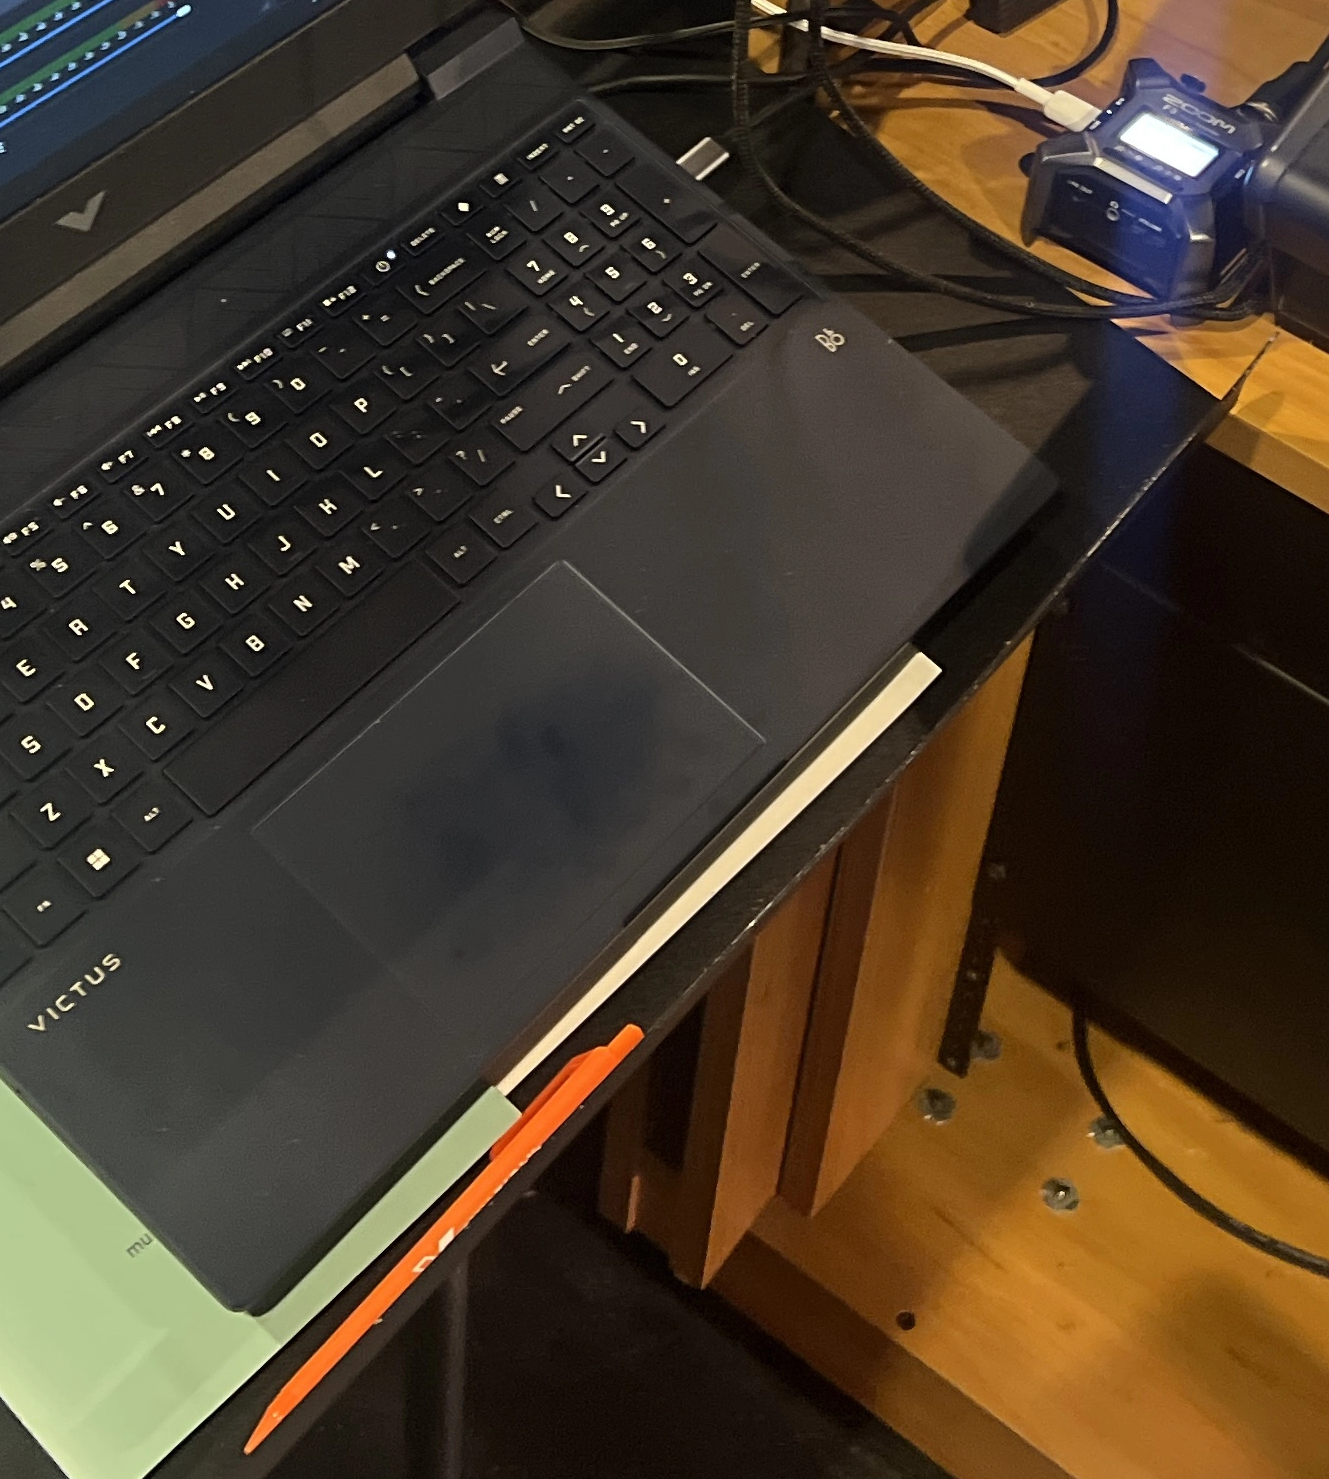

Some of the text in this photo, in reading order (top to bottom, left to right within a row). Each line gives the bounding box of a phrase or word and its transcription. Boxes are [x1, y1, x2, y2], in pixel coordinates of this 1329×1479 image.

[290, 377, 306, 391] 0
[353, 397, 368, 413] P
[244, 411, 261, 426] 9
[198, 446, 215, 461] 8
[363, 466, 383, 478] L
[149, 482, 165, 496] 7
[216, 503, 236, 521] U
[318, 498, 338, 515] K
[101, 520, 119, 535] 6
[168, 541, 186, 556] Y
[277, 535, 291, 552] J
[50, 557, 69, 573] 5
[338, 555, 361, 575] M
[118, 579, 137, 595] T
[224, 573, 245, 590] H
[0, 596, 17, 610] 4
[292, 595, 313, 612] N
[68, 618, 89, 636] R
[175, 612, 196, 630] G
[245, 634, 265, 652] B
[15, 659, 36, 677] E
[125, 652, 140, 670] F
[195, 674, 214, 691] V
[73, 693, 95, 712] D
[145, 716, 166, 734] C
[20, 735, 42, 754] S
[93, 758, 115, 778] X
[39, 802, 61, 822] Z
[28, 951, 123, 1033] VICTUS
[126, 1232, 154, 1258] mu
